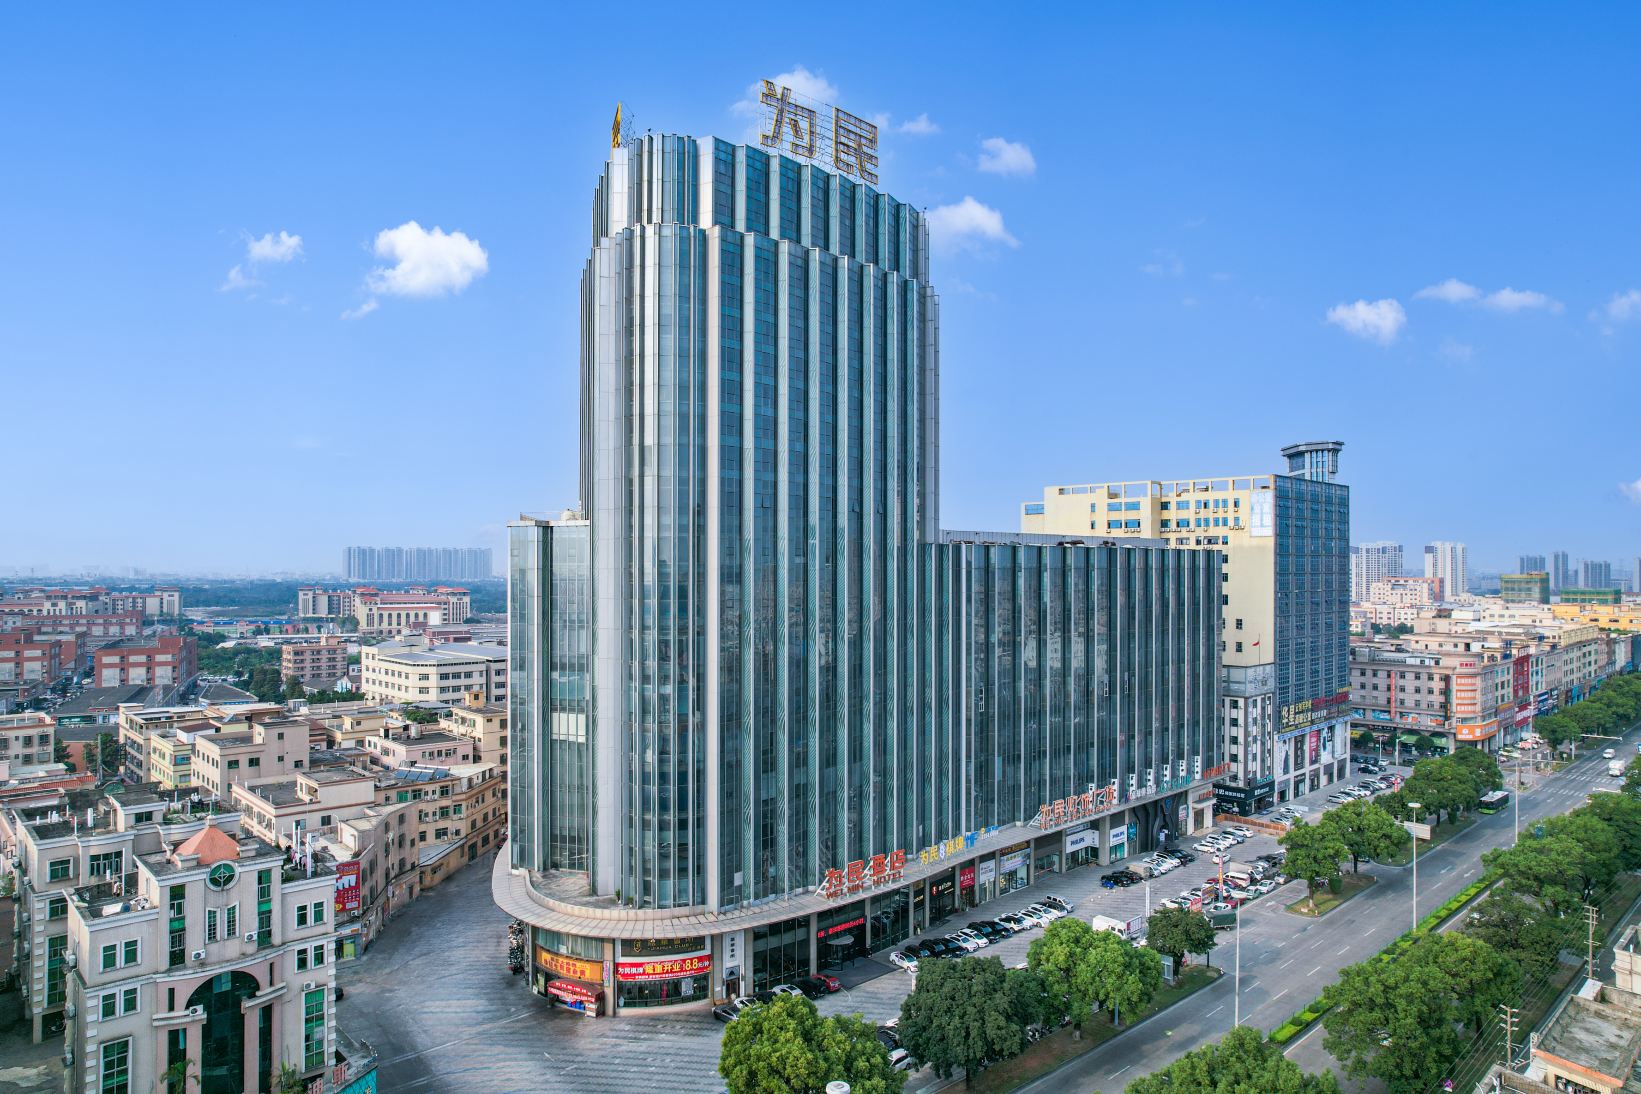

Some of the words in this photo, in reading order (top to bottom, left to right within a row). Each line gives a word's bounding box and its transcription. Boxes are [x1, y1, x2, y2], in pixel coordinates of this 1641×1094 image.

[760, 79, 879, 185] 为民
[1039, 785, 1115, 821] 为民灯饰广场
[1070, 837, 1085, 846] PHILIPS
[825, 849, 906, 890] 为民酒店
[848, 883, 864, 893] MIN
[873, 871, 904, 886] HOTEL
[644, 962, 680, 974] 隆重开业
